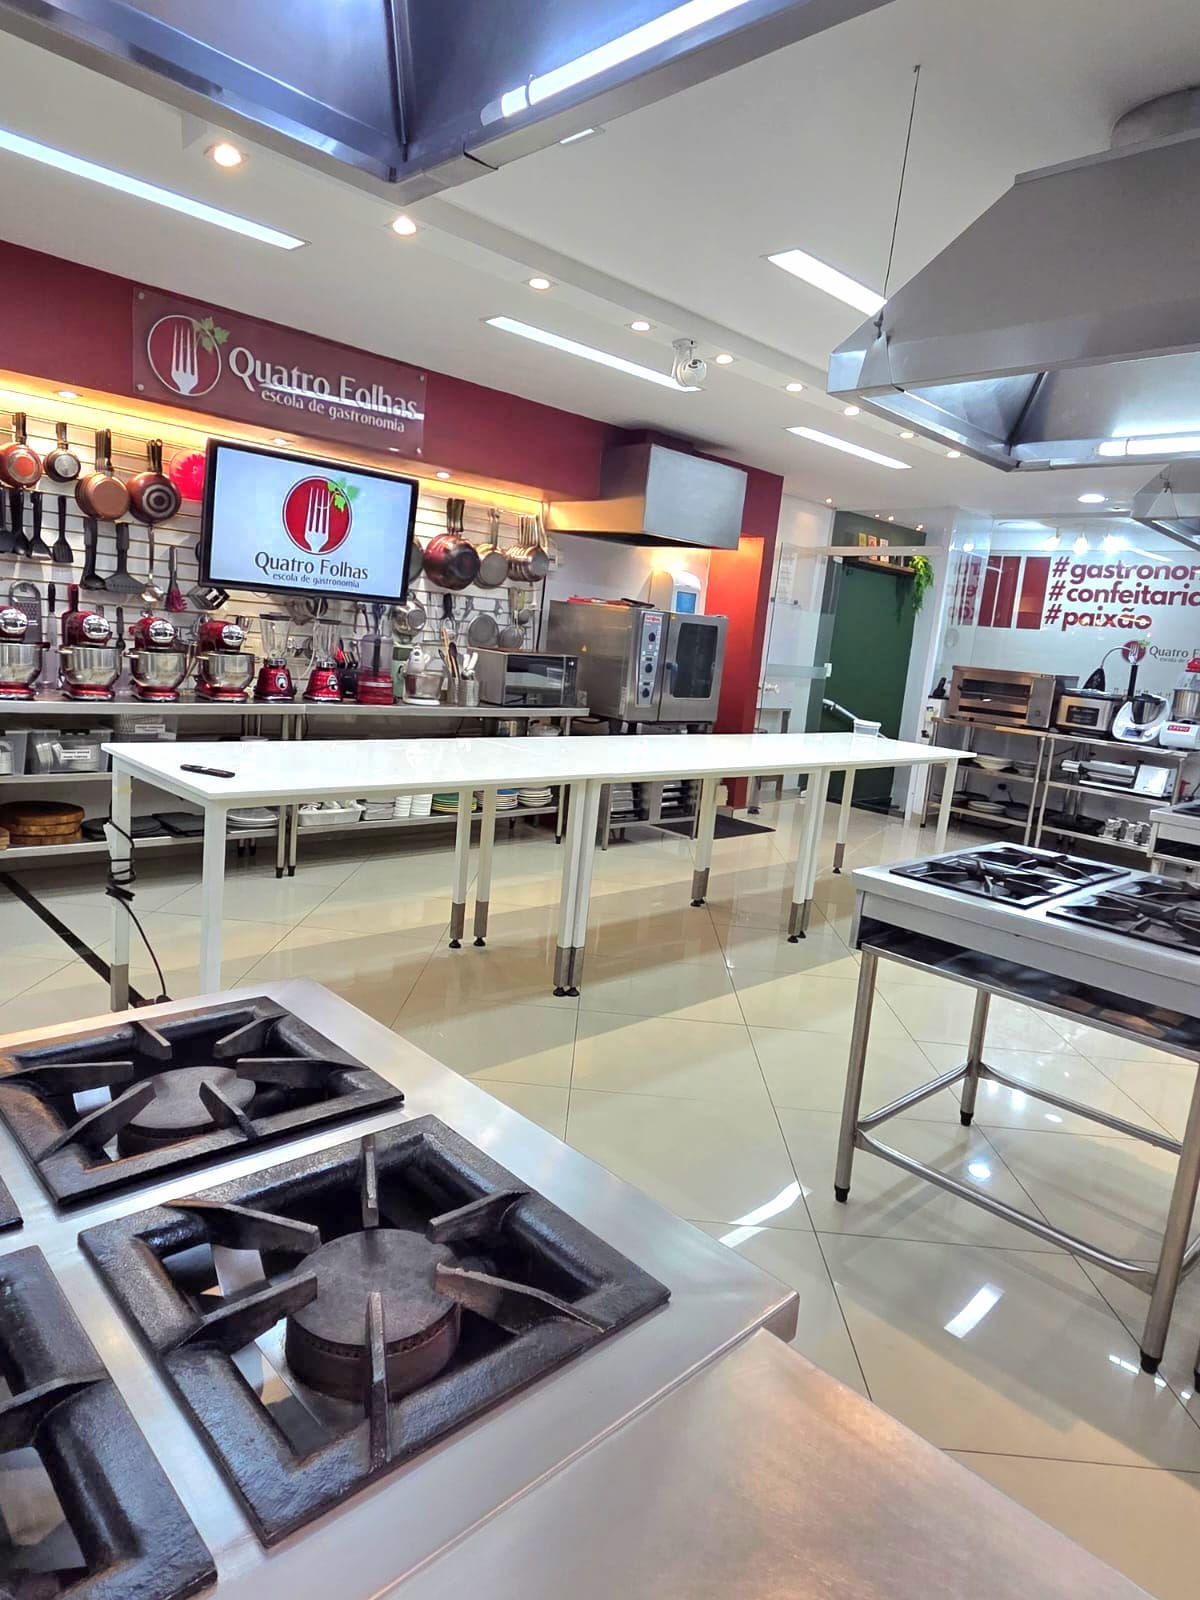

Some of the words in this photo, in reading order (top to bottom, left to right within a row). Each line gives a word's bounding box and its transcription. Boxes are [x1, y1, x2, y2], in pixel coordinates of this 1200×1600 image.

[229, 346, 330, 397] Quatro
[340, 375, 417, 419] Folhas
[261, 389, 304, 409] escola
[308, 399, 325, 414] de
[328, 406, 405, 433] gastronomia
[255, 551, 315, 576] Quatro
[320, 559, 369, 580] Folhas
[272, 572, 298, 582] escola
[300, 574, 310, 584] de
[312, 577, 360, 589] gastronomia
[1044, 603, 1153, 632] #paixão
[1149, 645, 1189, 660] Quatro
